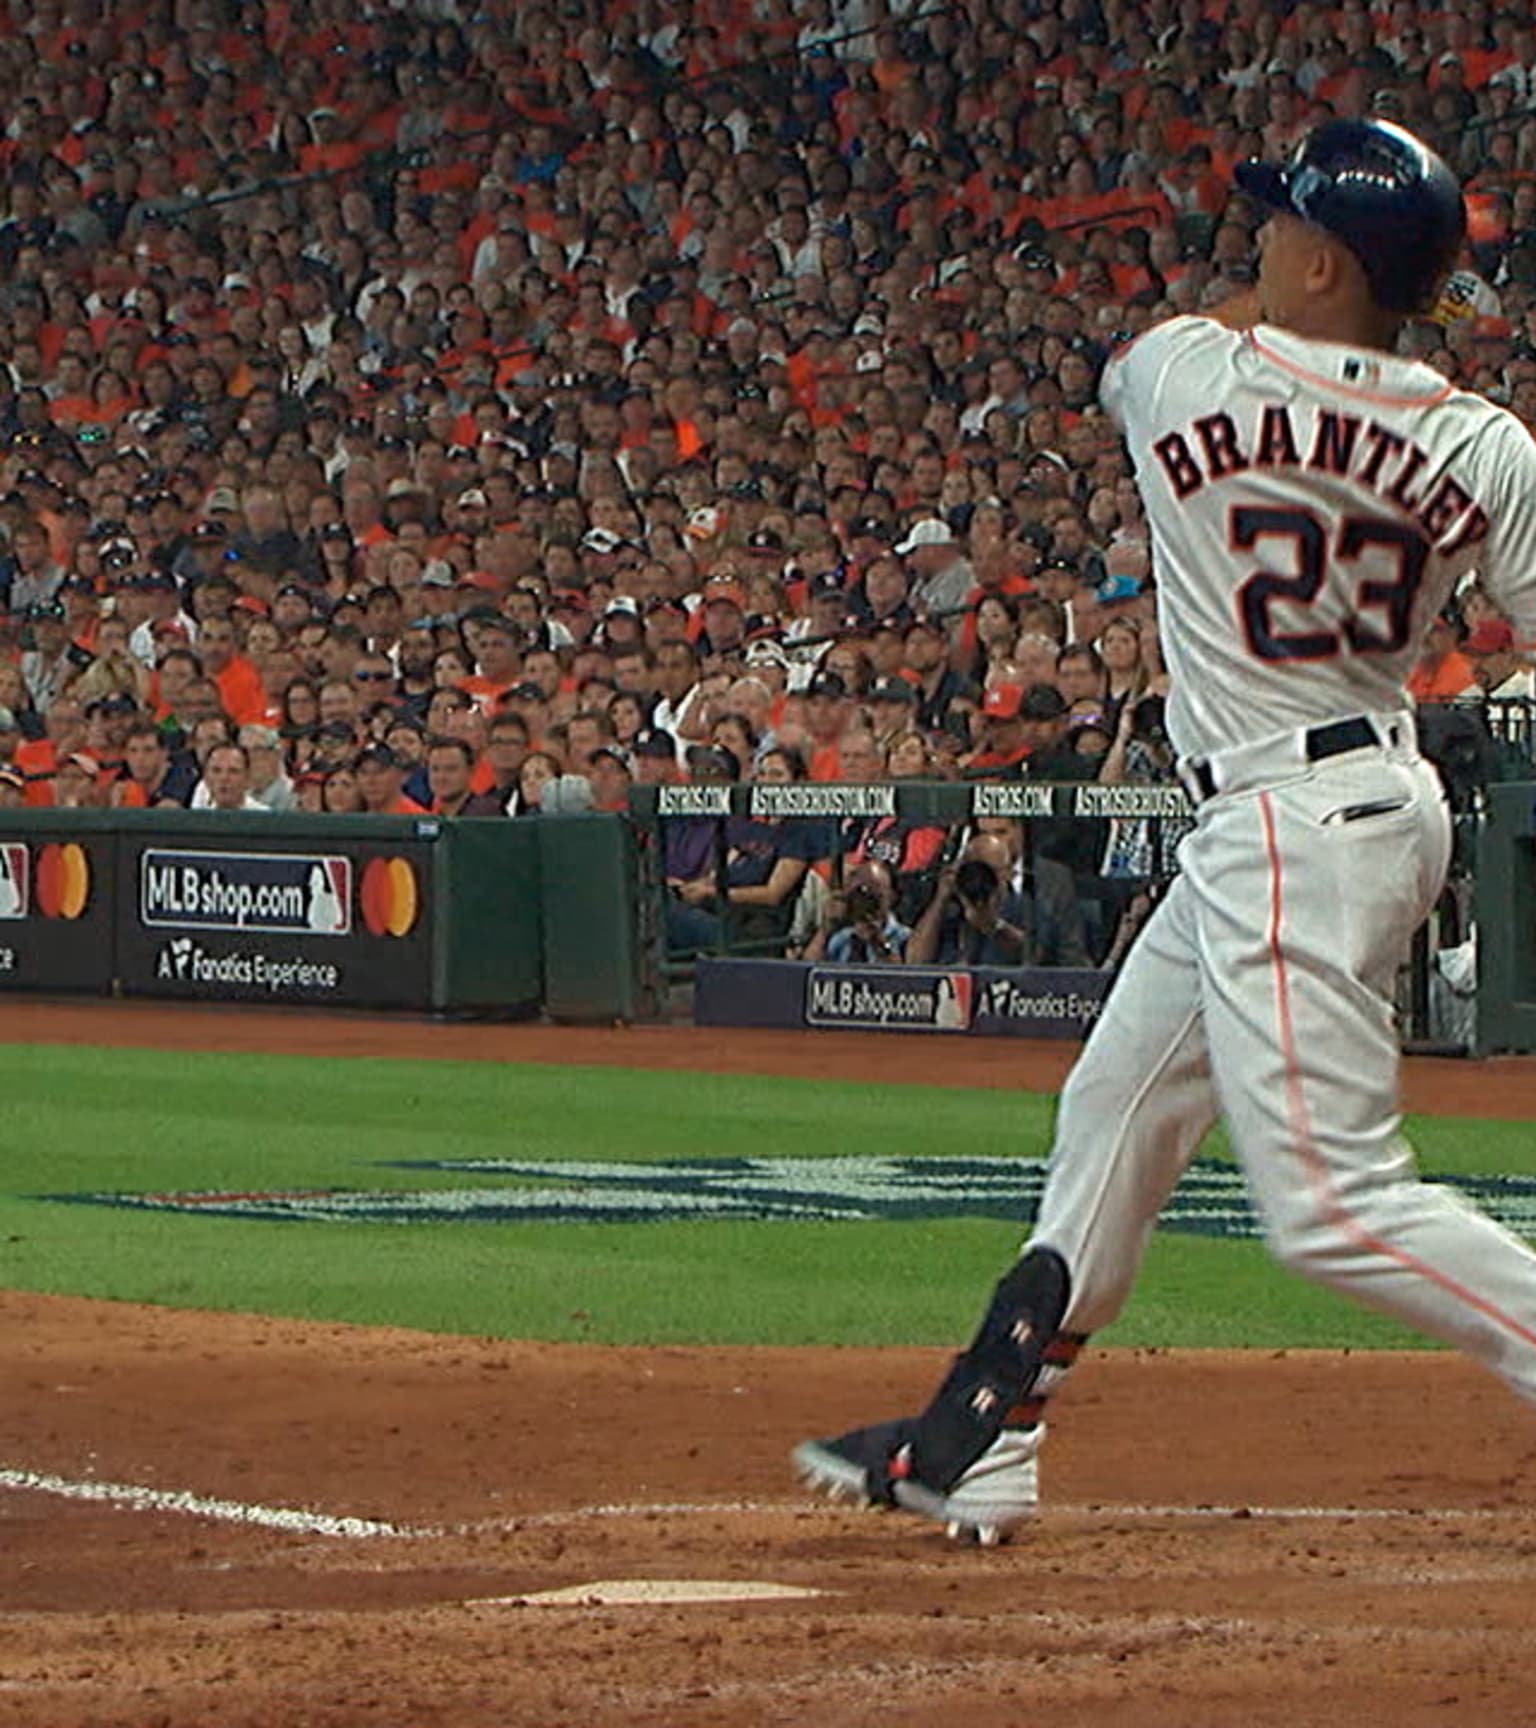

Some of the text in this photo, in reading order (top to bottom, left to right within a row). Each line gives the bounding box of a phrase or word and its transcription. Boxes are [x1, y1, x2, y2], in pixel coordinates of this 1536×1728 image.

[1153, 405, 1490, 558] BRANTLEY
[1228, 502, 1434, 663] 23
[158, 947, 338, 992] A Fanatics Experience
[977, 993, 989, 1017] A
[1009, 989, 1065, 1018] Fanatics
